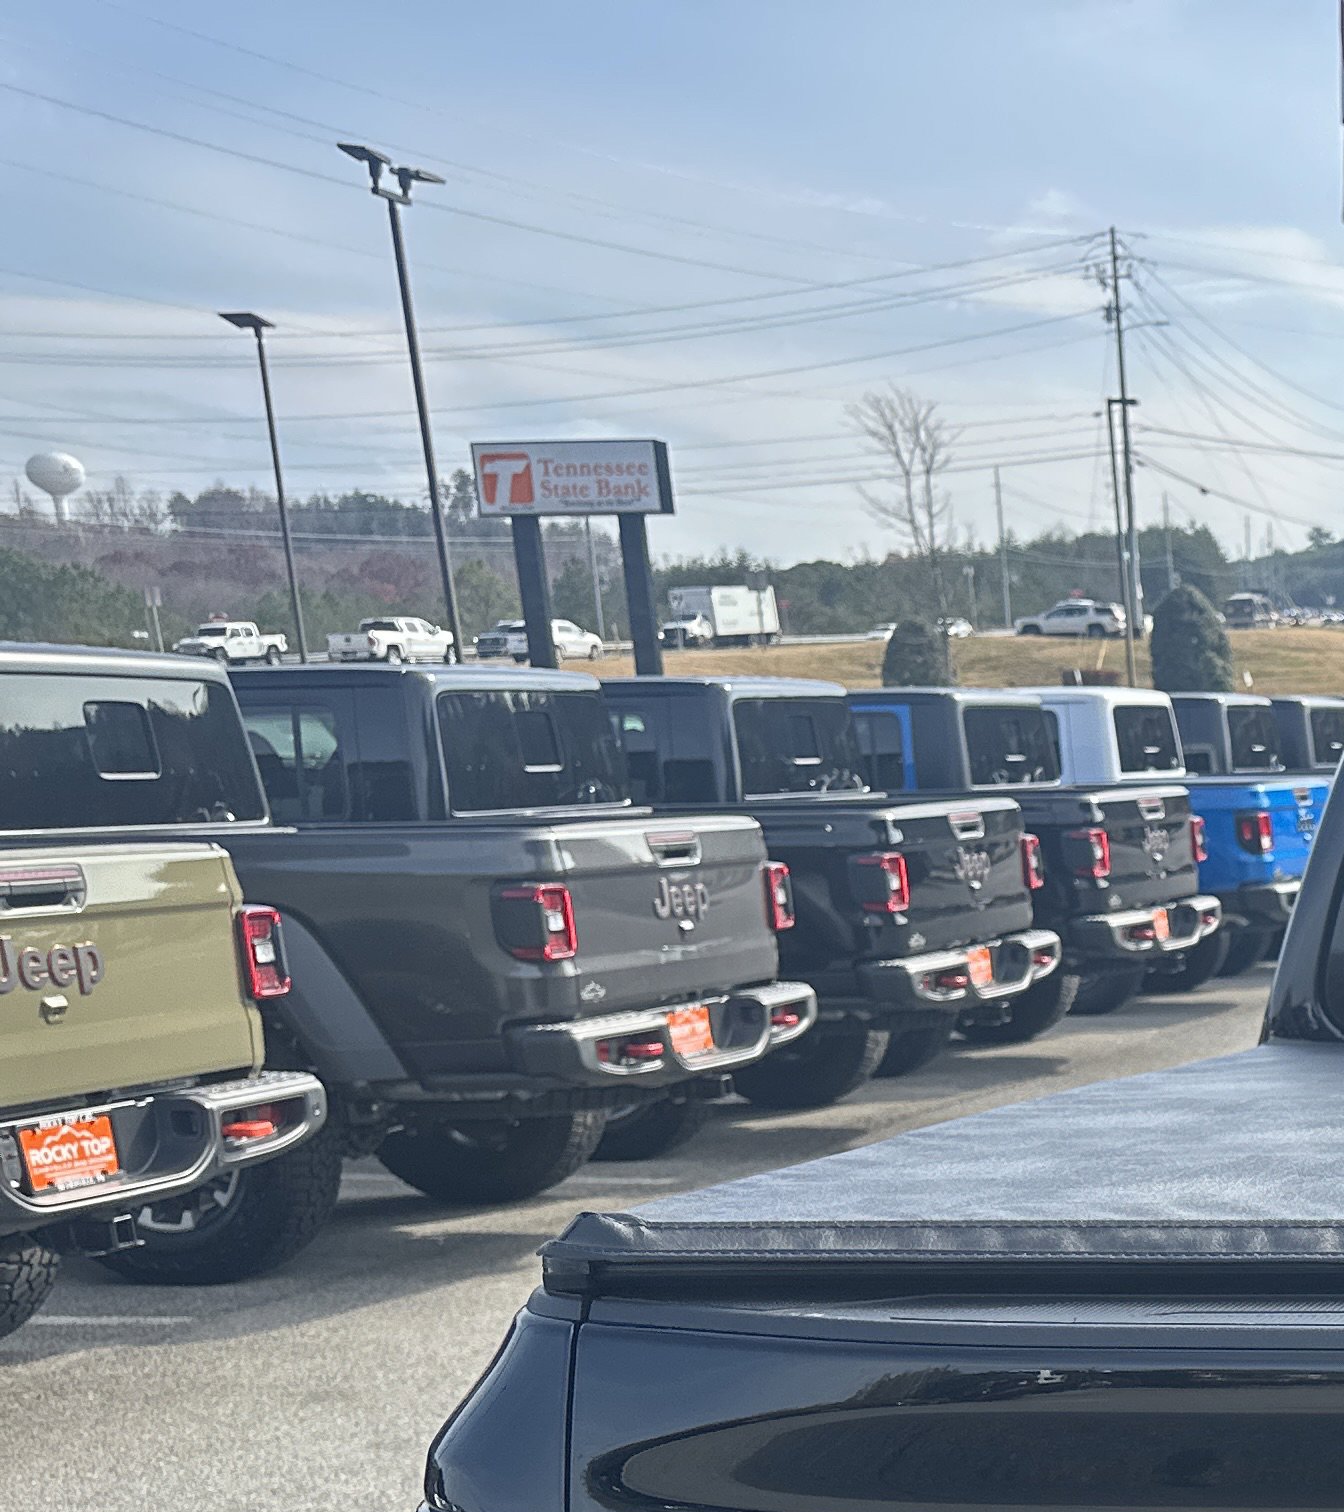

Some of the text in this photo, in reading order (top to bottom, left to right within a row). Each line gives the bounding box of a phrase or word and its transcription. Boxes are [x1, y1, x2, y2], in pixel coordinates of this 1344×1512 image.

[537, 458, 649, 478] Tennessee
[540, 478, 650, 499] State Bank
[654, 876, 710, 921] Jeep
[0, 935, 105, 995] Jeep
[29, 1143, 79, 1167] ROCKY
[80, 1137, 111, 1157] TOP
